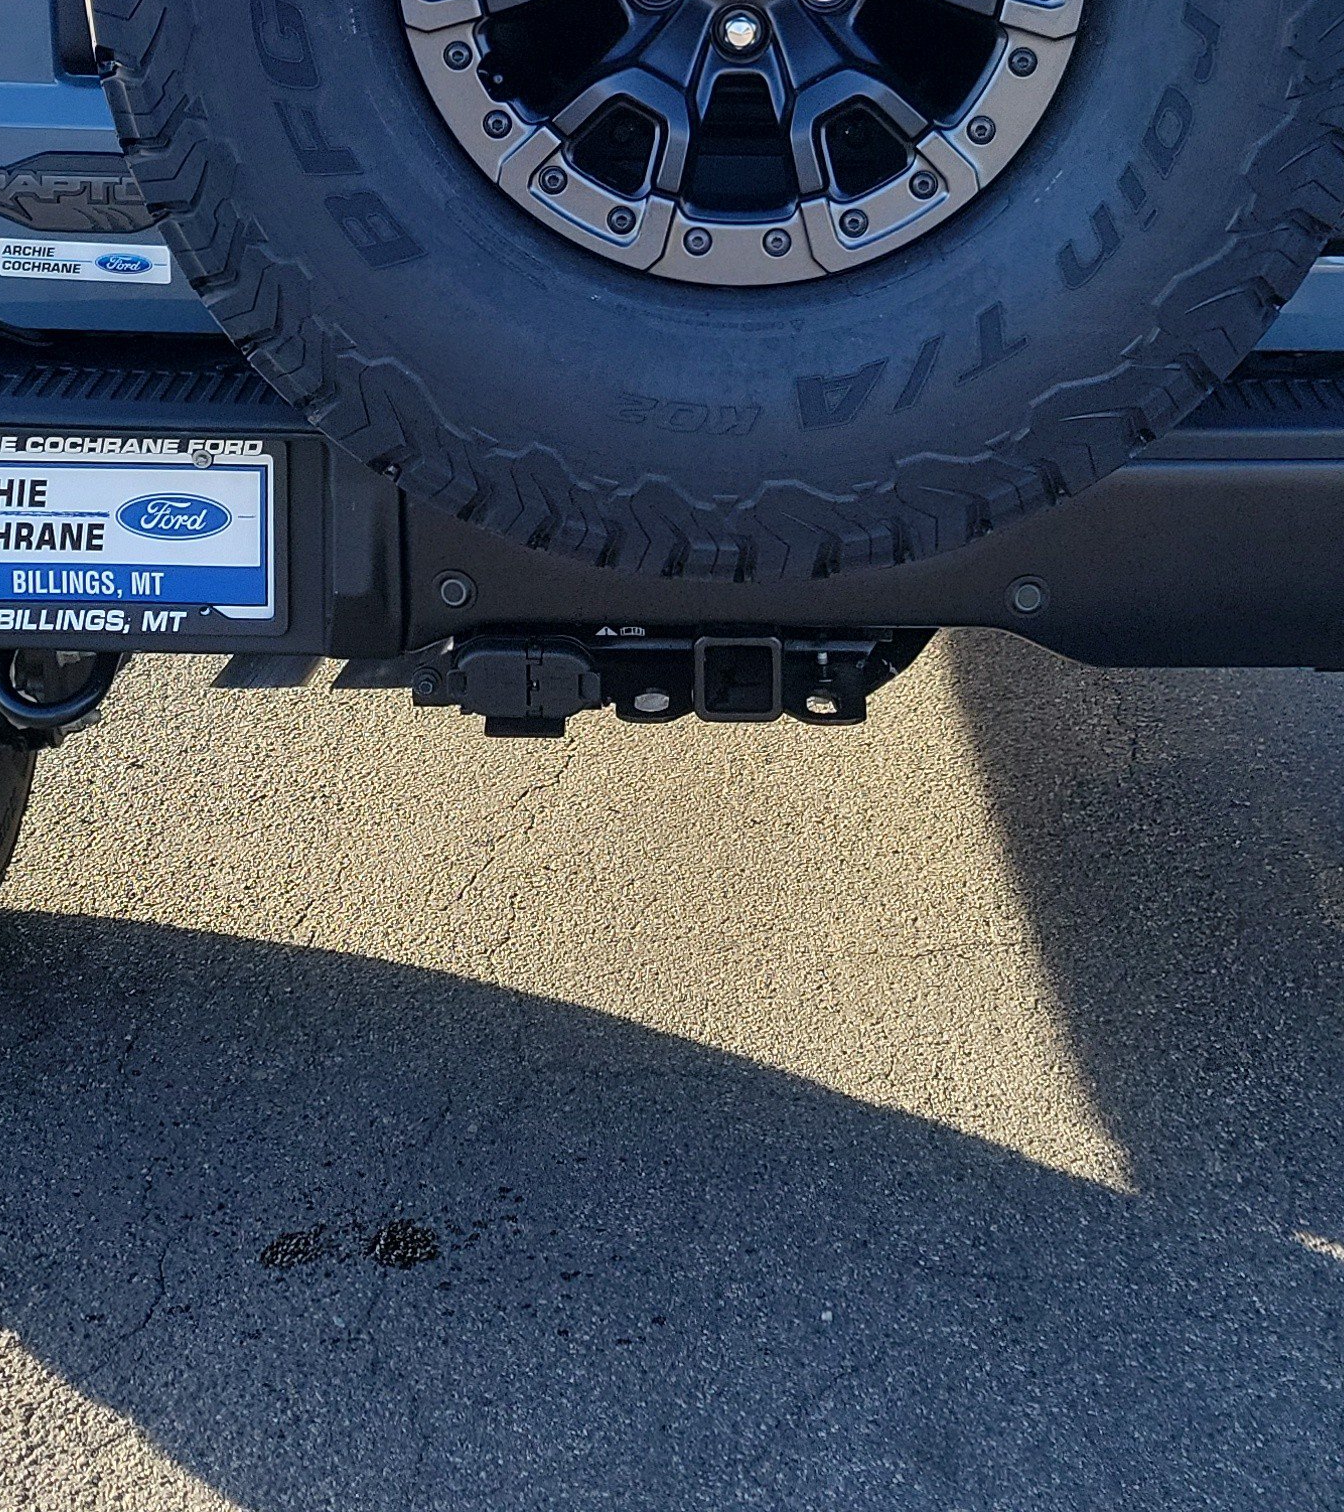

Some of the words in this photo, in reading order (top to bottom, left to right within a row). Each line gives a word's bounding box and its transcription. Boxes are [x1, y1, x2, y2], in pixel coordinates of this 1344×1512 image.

[2, 245, 55, 257] ARCHIE
[2, 260, 81, 274] COCHRANE
[106, 257, 141, 271] Ford
[793, 300, 1031, 432] T/A
[26, 437, 180, 455] COCHRANE
[187, 439, 263, 456] FORD
[140, 500, 208, 531] Ford
[12, 569, 123, 599] BILLINGS,
[130, 571, 165, 597] MT
[140, 610, 188, 633] MT
